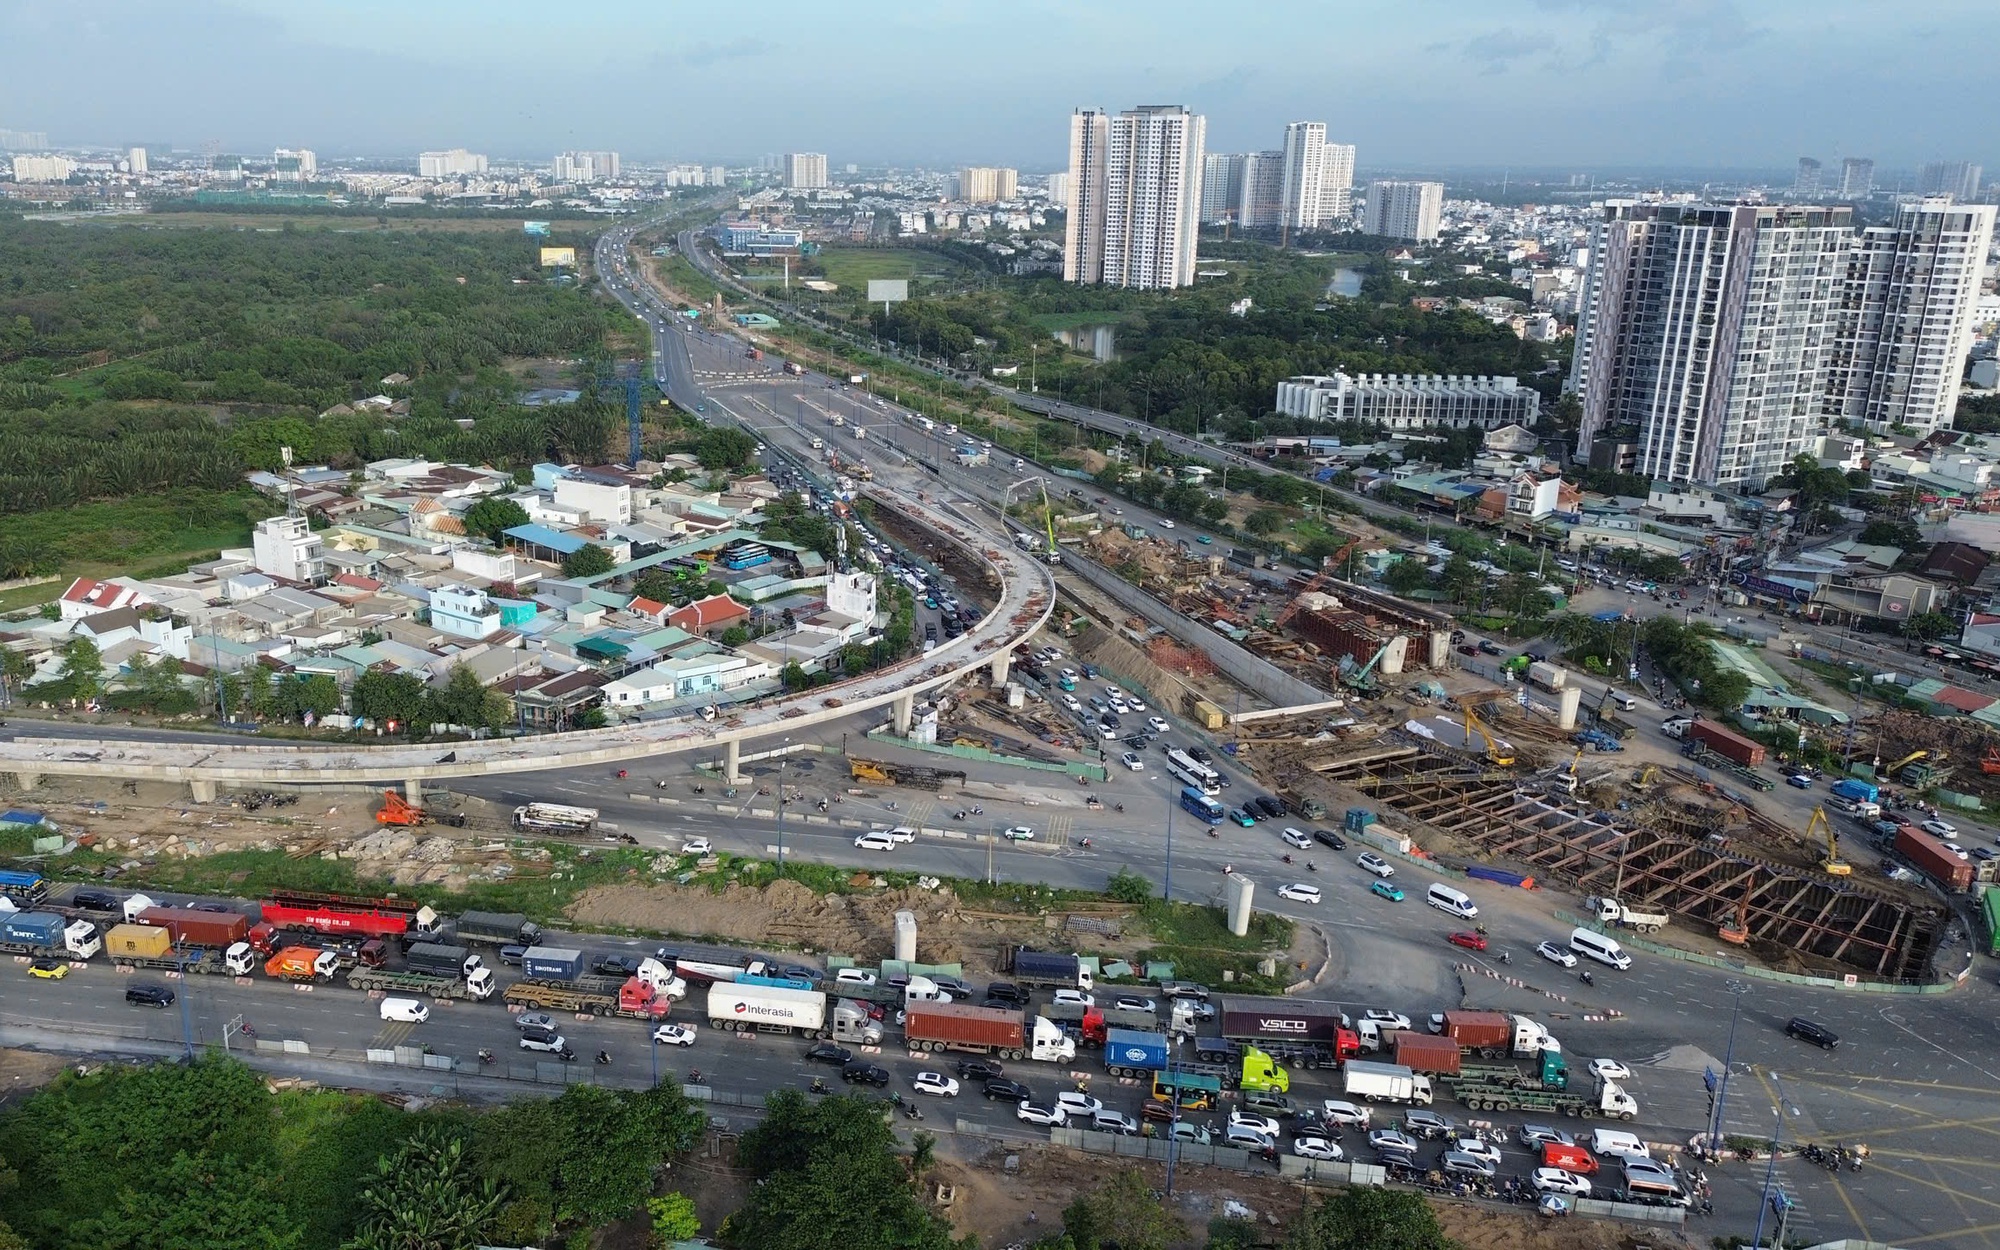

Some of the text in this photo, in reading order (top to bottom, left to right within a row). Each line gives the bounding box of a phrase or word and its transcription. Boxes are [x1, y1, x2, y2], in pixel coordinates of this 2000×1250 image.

[12, 931, 37, 939] KMTC
[535, 965, 562, 973] SINOTRANS
[748, 1004, 793, 1018] Interasia
